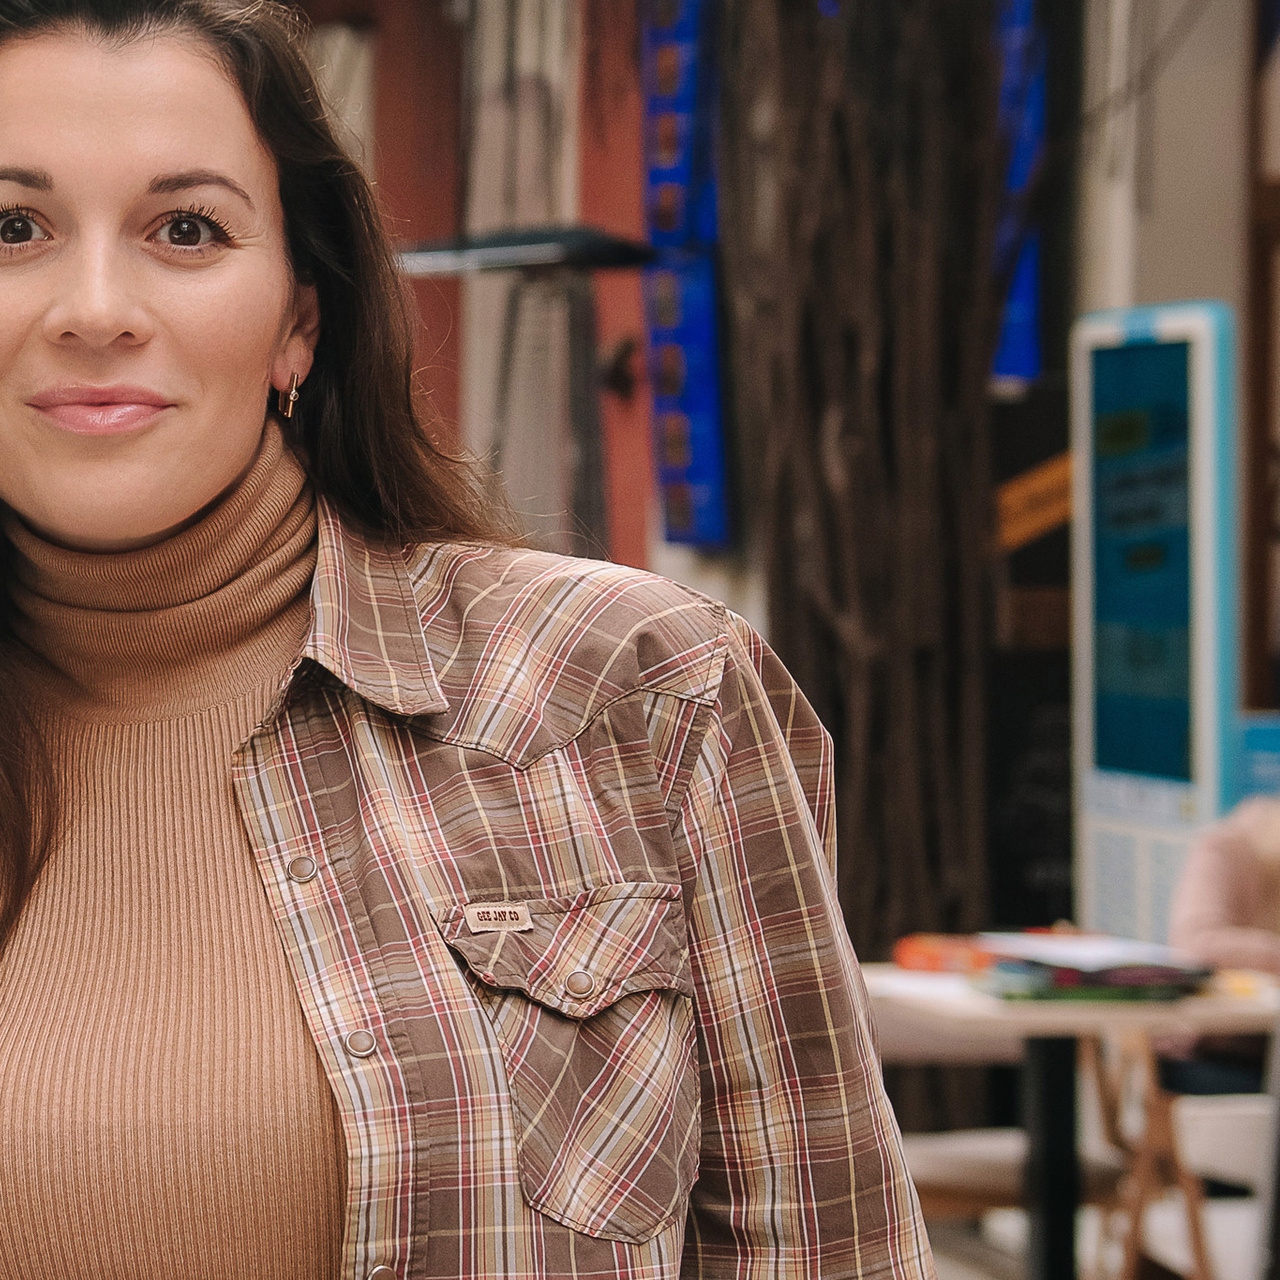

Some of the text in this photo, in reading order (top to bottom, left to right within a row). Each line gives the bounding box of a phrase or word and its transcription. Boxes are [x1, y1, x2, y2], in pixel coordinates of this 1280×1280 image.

[477, 910, 520, 921] GEE JAY CO
